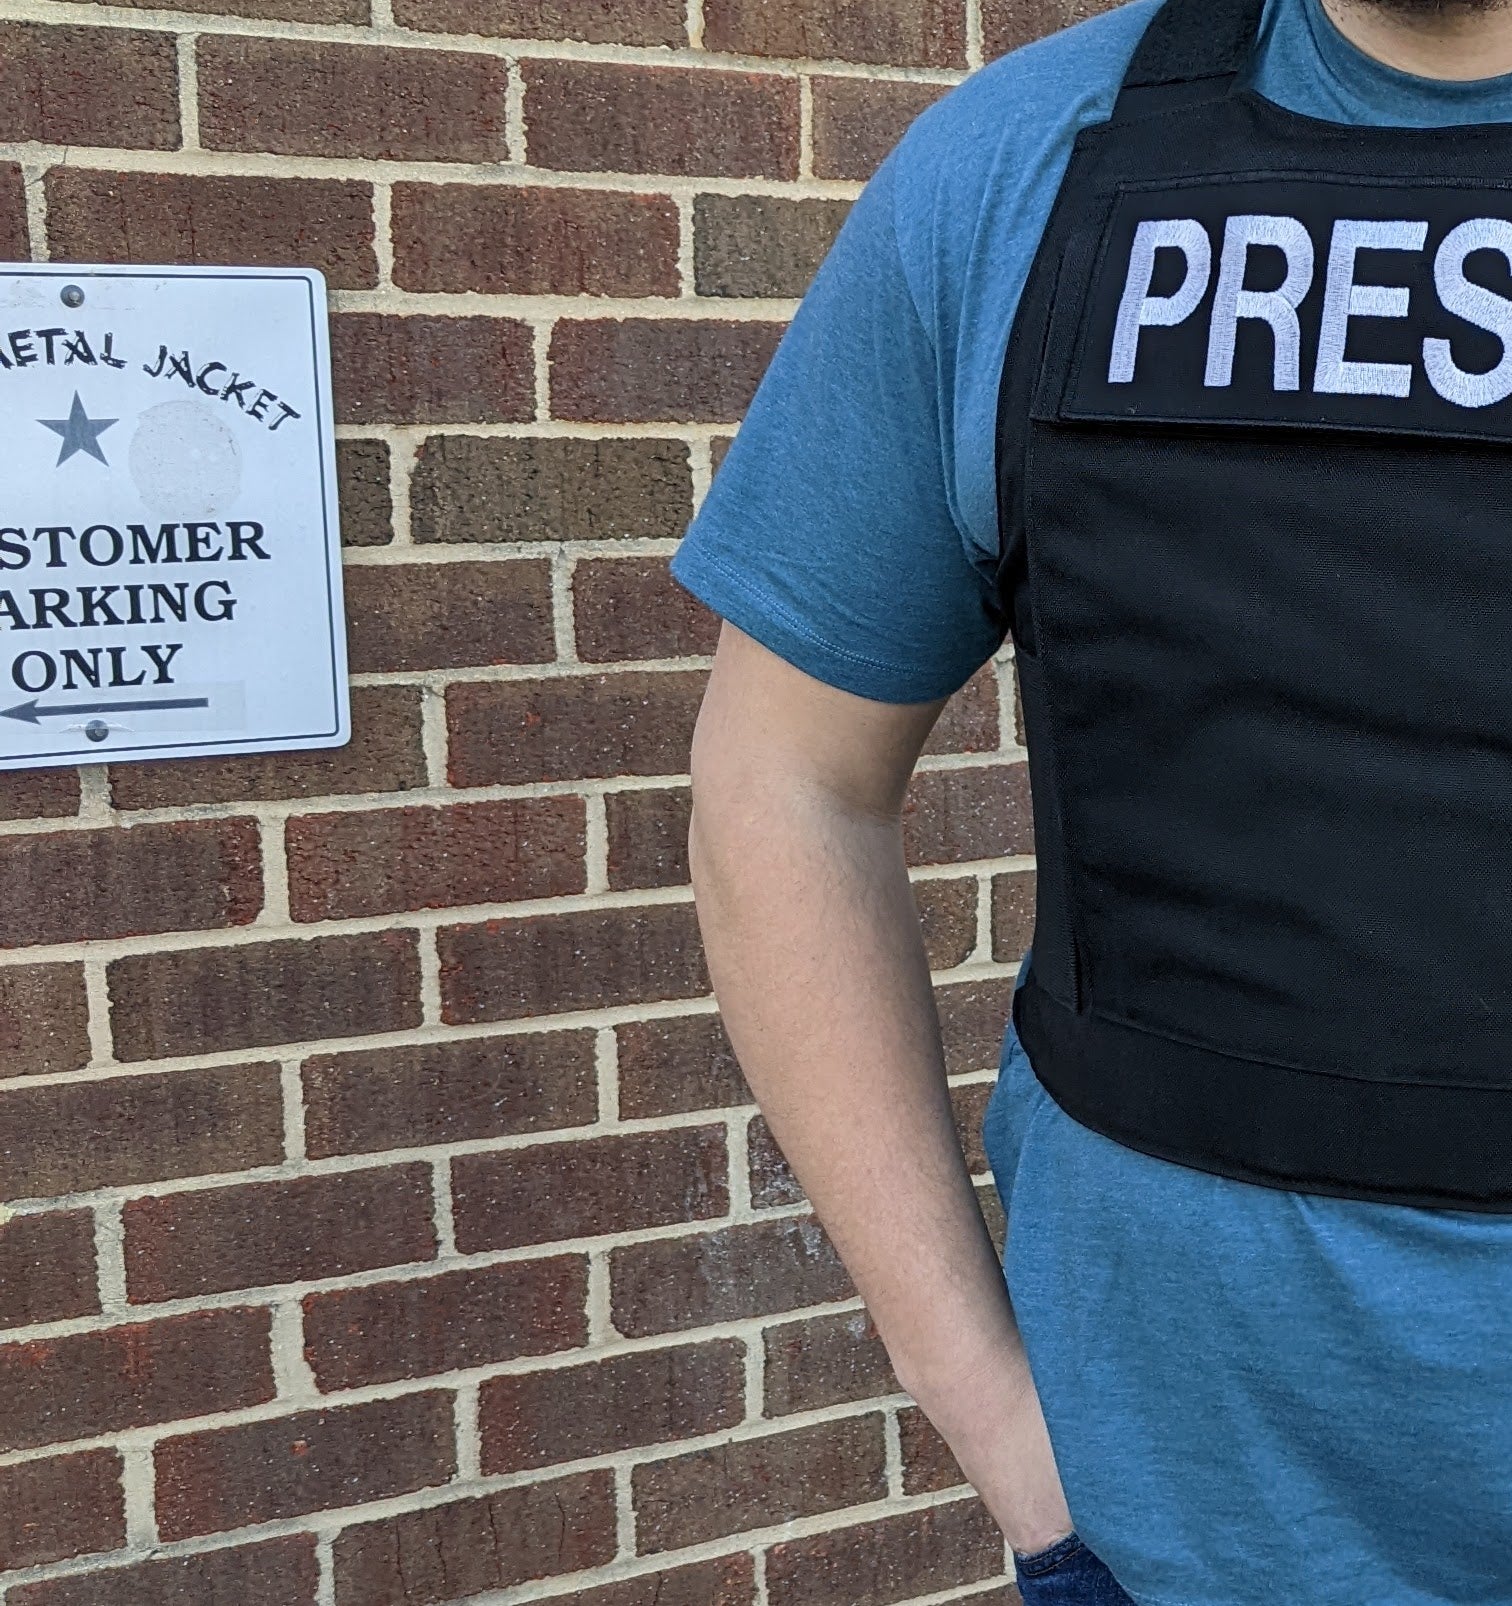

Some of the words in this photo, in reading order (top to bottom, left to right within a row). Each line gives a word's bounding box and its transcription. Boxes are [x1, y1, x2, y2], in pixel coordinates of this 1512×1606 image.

[142, 344, 301, 431] JACKET
[0, 521, 271, 571] STOMER
[11, 643, 183, 693] ONLY
